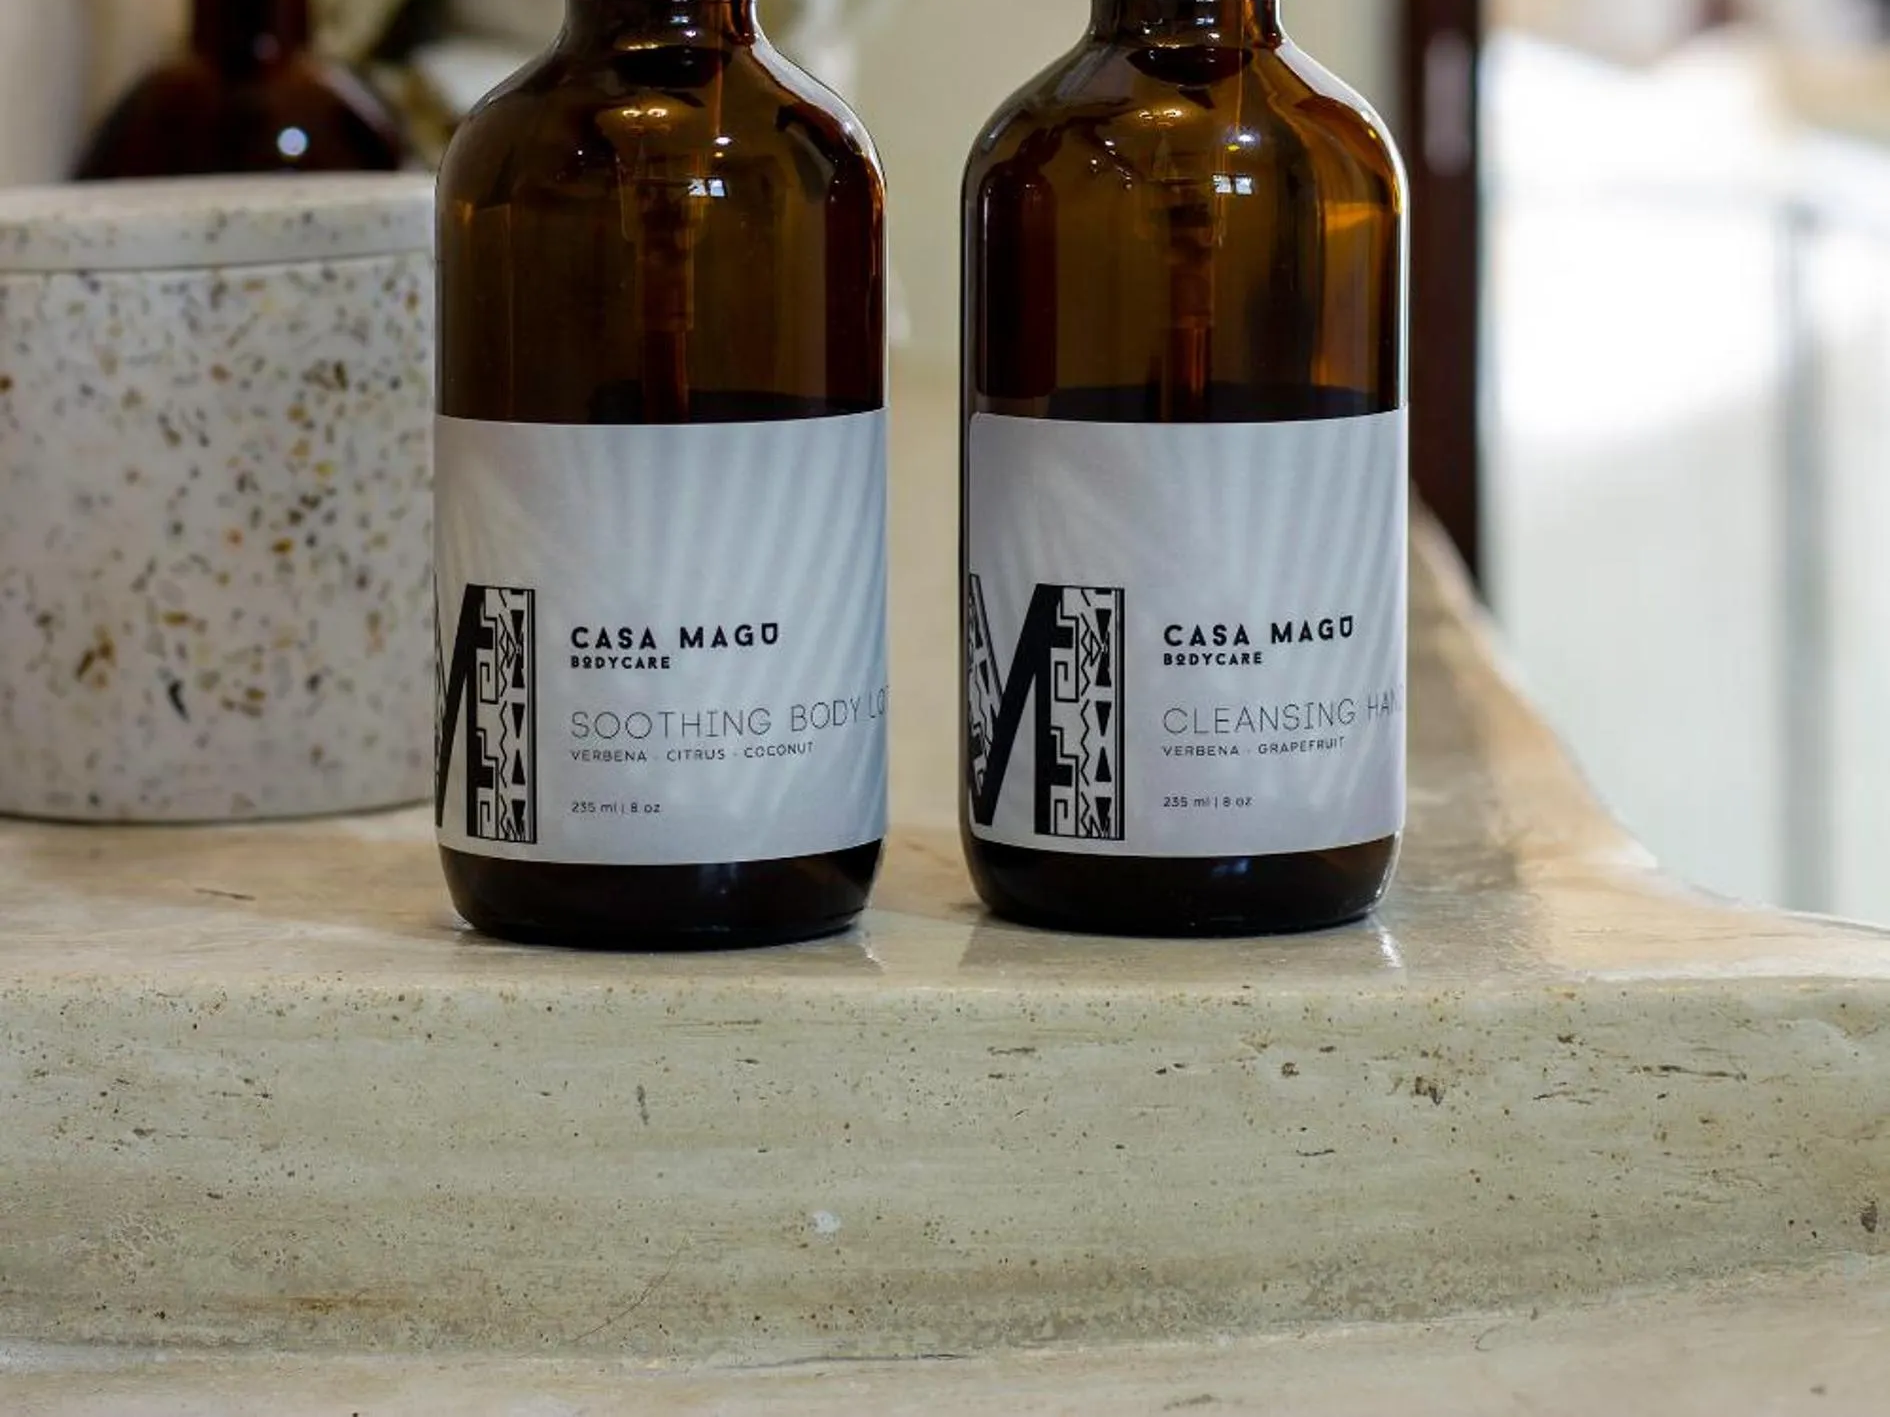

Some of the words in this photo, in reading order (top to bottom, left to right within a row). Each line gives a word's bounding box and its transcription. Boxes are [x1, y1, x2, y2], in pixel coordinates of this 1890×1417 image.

[571, 626, 656, 650] CASA
[1163, 624, 1250, 647] CASA
[571, 655, 670, 669] BODYCARE
[1163, 652, 1263, 666] BODYCARE
[571, 708, 772, 740] SOOTHING
[791, 696, 860, 733] BODY
[1163, 698, 1356, 736] CLEANSING
[571, 749, 648, 763] VERBENA
[667, 748, 726, 761] CITRUS
[744, 741, 814, 759] COCONUT
[1162, 745, 1240, 757] VERBENA
[1258, 736, 1345, 755] GRAPEFRUIT
[571, 801, 596, 814] 235
[600, 801, 618, 814] ml
[630, 801, 639, 814] 8
[643, 803, 661, 814] oz
[1163, 796, 1188, 808] 235
[1223, 796, 1231, 808] 8
[1235, 797, 1253, 808] oz
